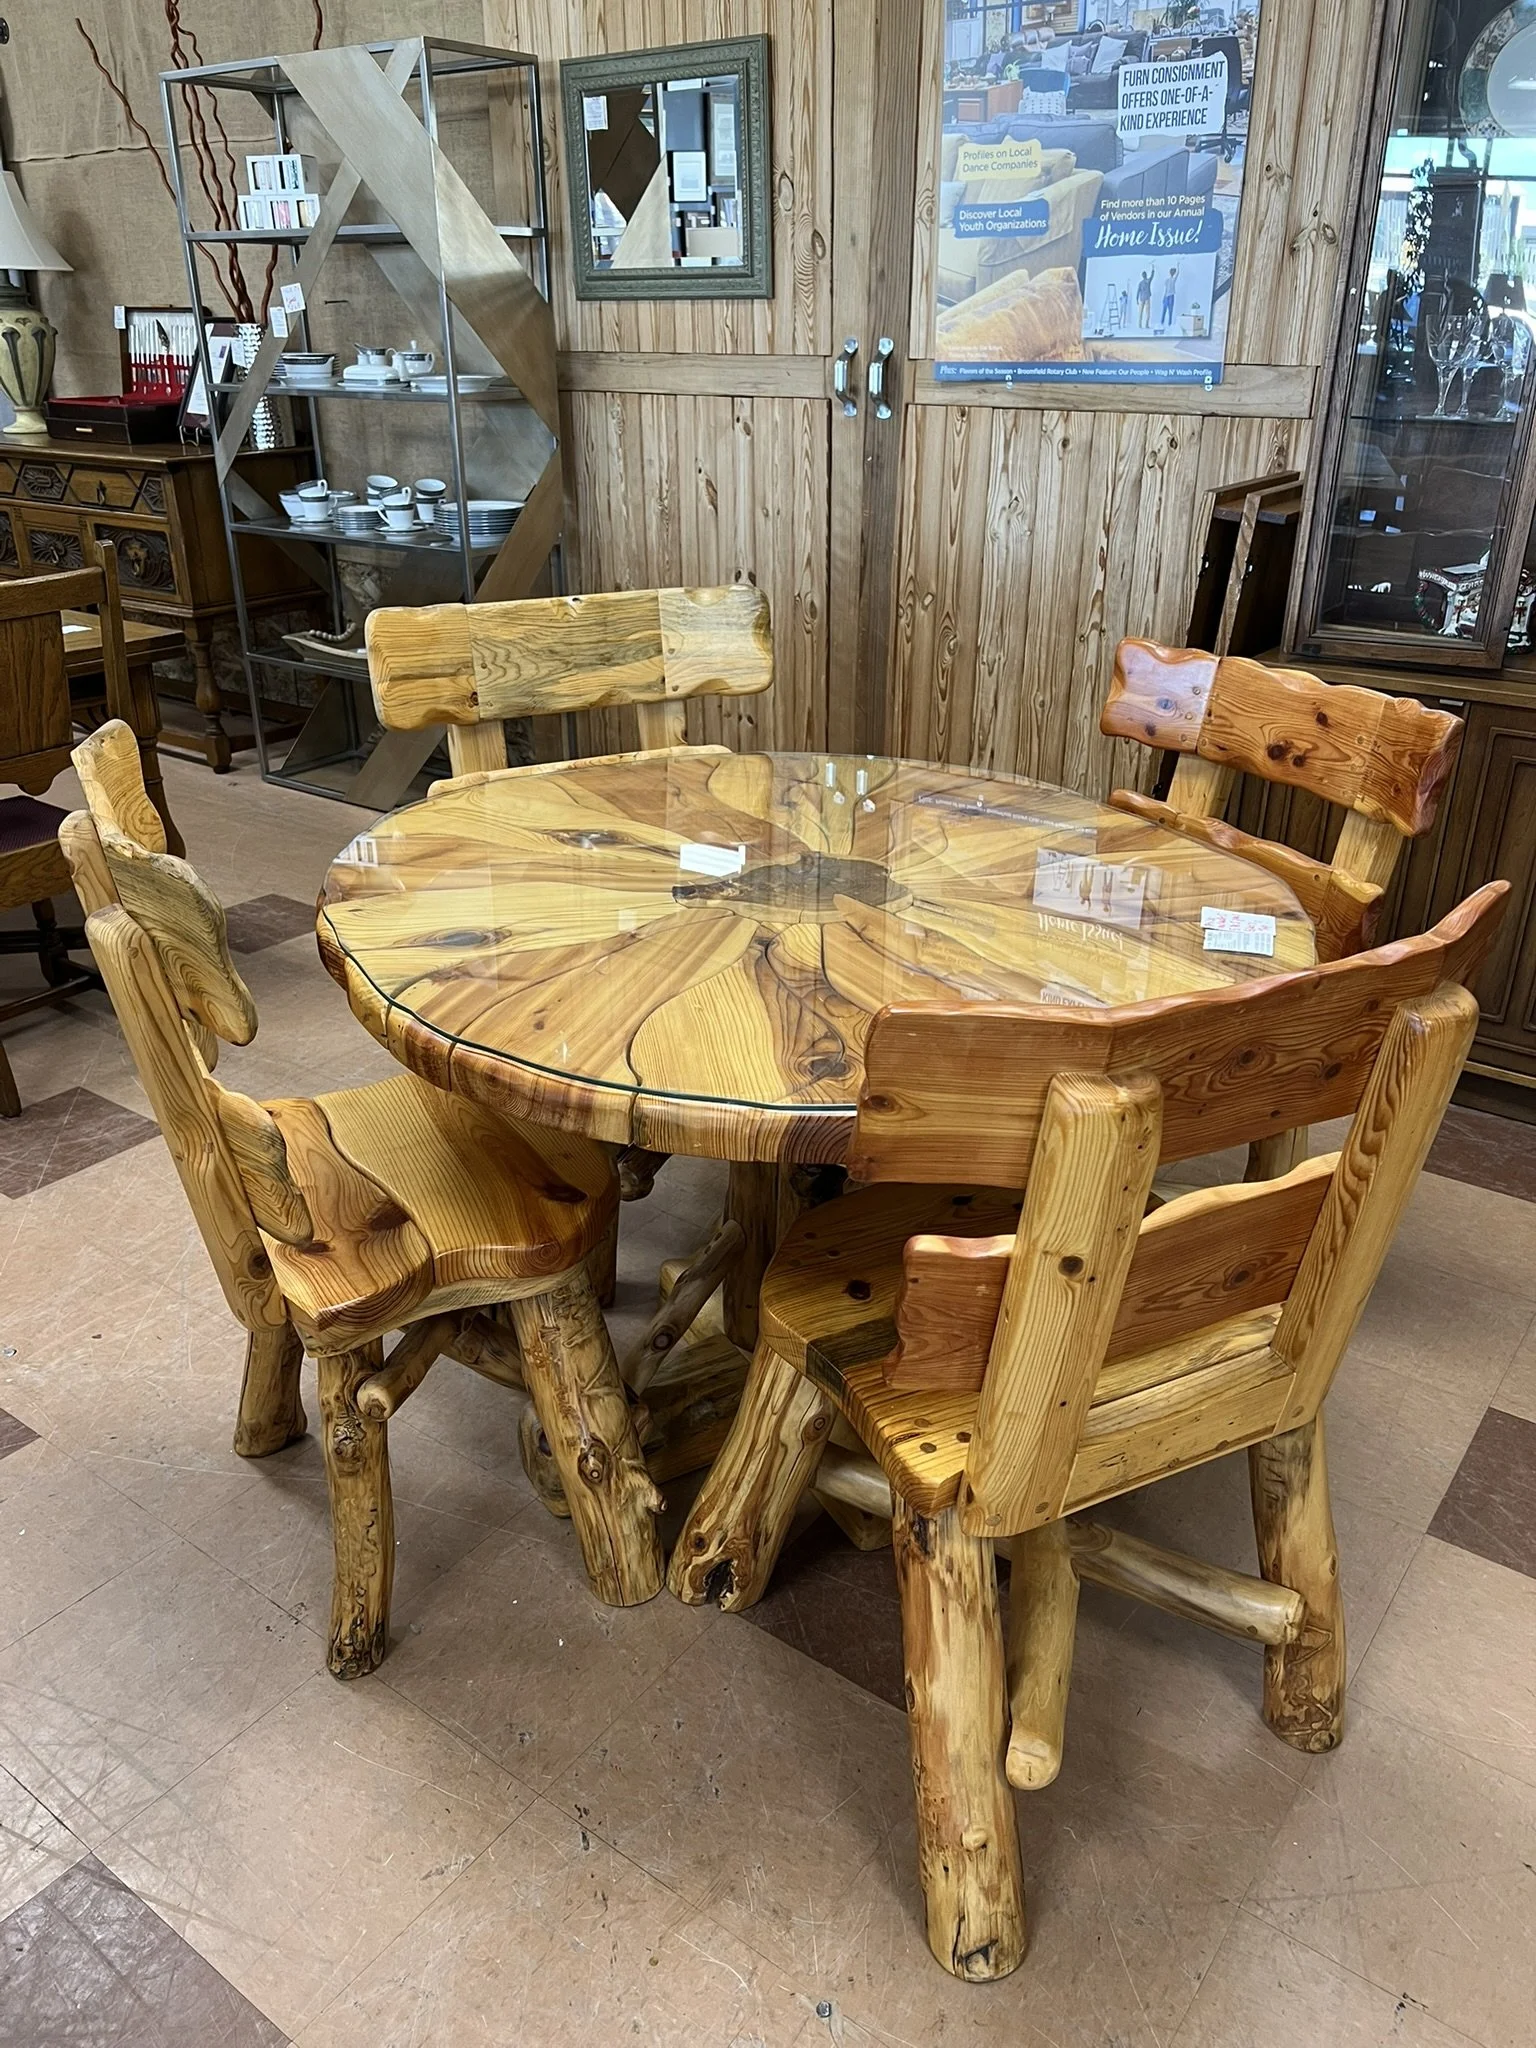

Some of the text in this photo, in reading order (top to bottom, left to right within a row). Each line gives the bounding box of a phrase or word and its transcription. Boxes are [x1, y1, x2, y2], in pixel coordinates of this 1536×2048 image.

[1123, 60, 1225, 87] FURN CONSIGNMENT
[1121, 85, 1213, 109] OFFERS ONE-OF-A-
[1120, 108, 1208, 131] KIND EXPERIENCE
[963, 146, 1032, 161] Profiles on Local
[962, 160, 1038, 173] Dance Companies
[1101, 195, 1206, 209] Find more than 10 Pages
[959, 206, 1022, 220] Discover Local
[1100, 206, 1205, 221] of Vendors in our Annual
[959, 218, 1047, 232] Youth Organizations
[1094, 219, 1203, 249] Home Issue!
[985, 367, 994, 375] the
[1017, 367, 1046, 375] Broomfield
[1065, 367, 1078, 375] Club
